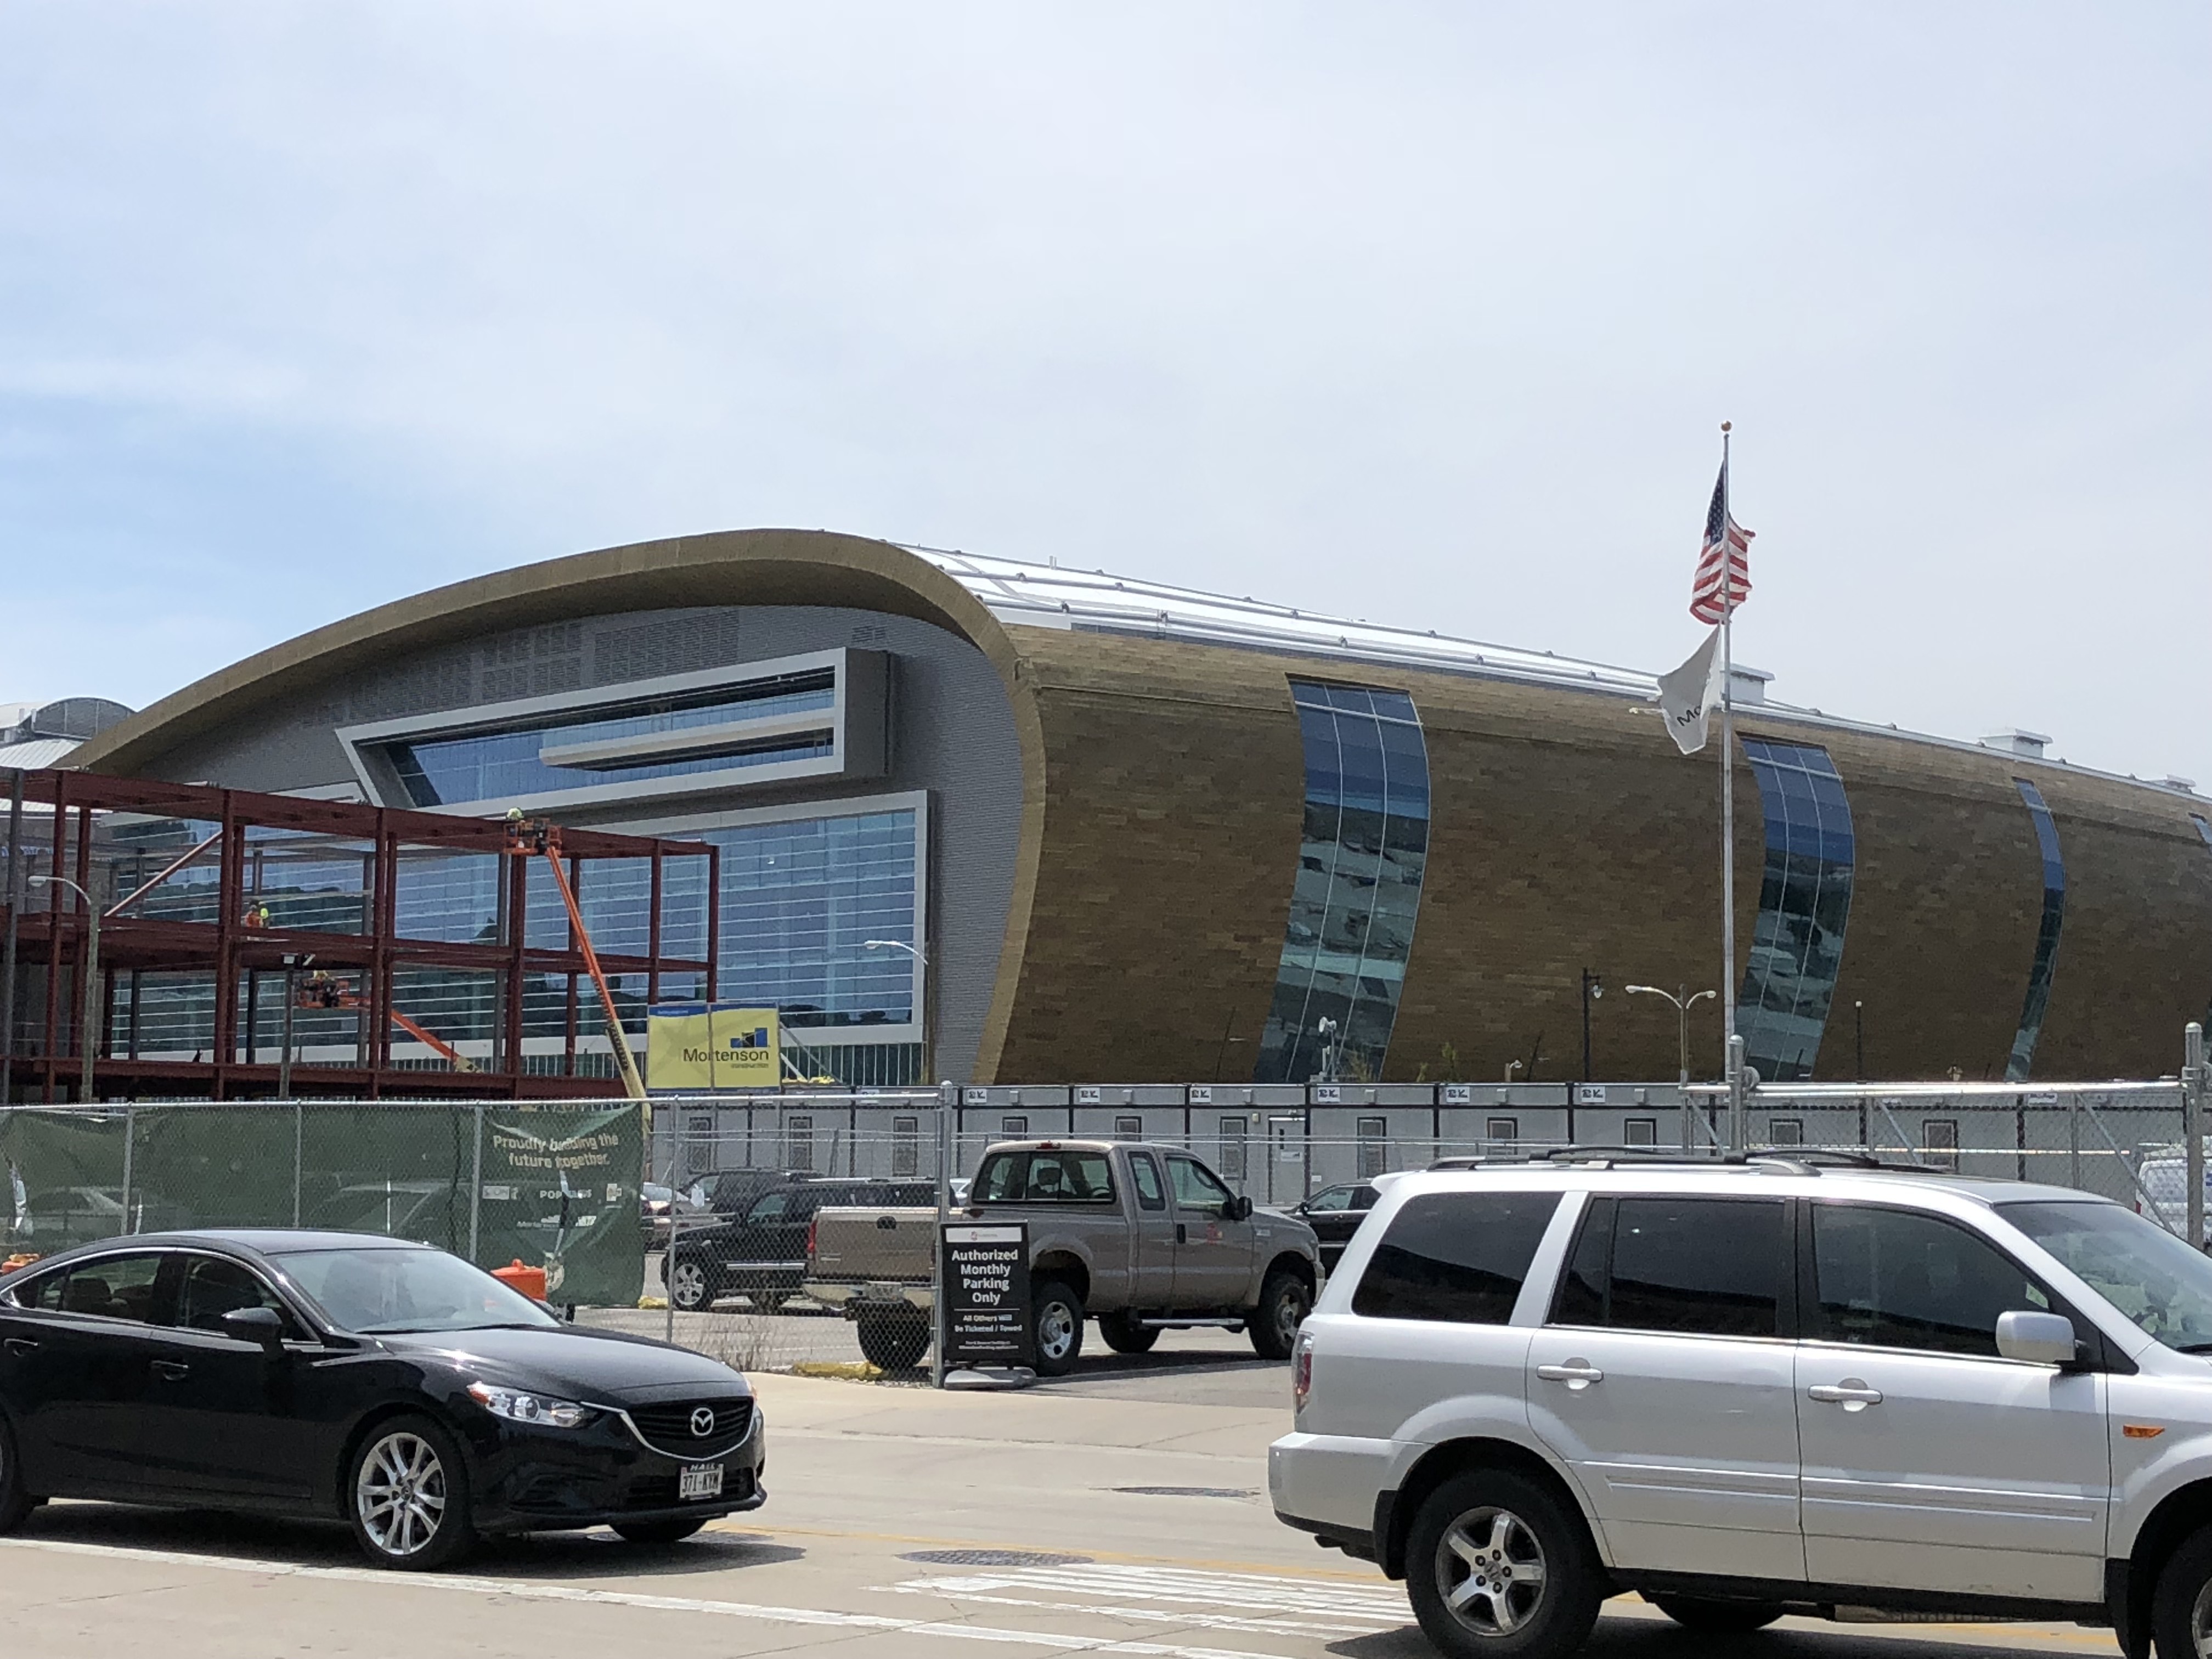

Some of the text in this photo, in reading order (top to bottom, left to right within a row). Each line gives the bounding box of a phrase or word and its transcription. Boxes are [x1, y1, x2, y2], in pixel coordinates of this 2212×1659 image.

[683, 1048, 769, 1062] Mortenson
[493, 1133, 619, 1153] Proudly buding the
[509, 1153, 552, 1169] future
[952, 1249, 1018, 1261] Authorized
[961, 1263, 1011, 1277] Monthly
[963, 1278, 1010, 1291] Parking
[972, 1291, 1001, 1306] Only
